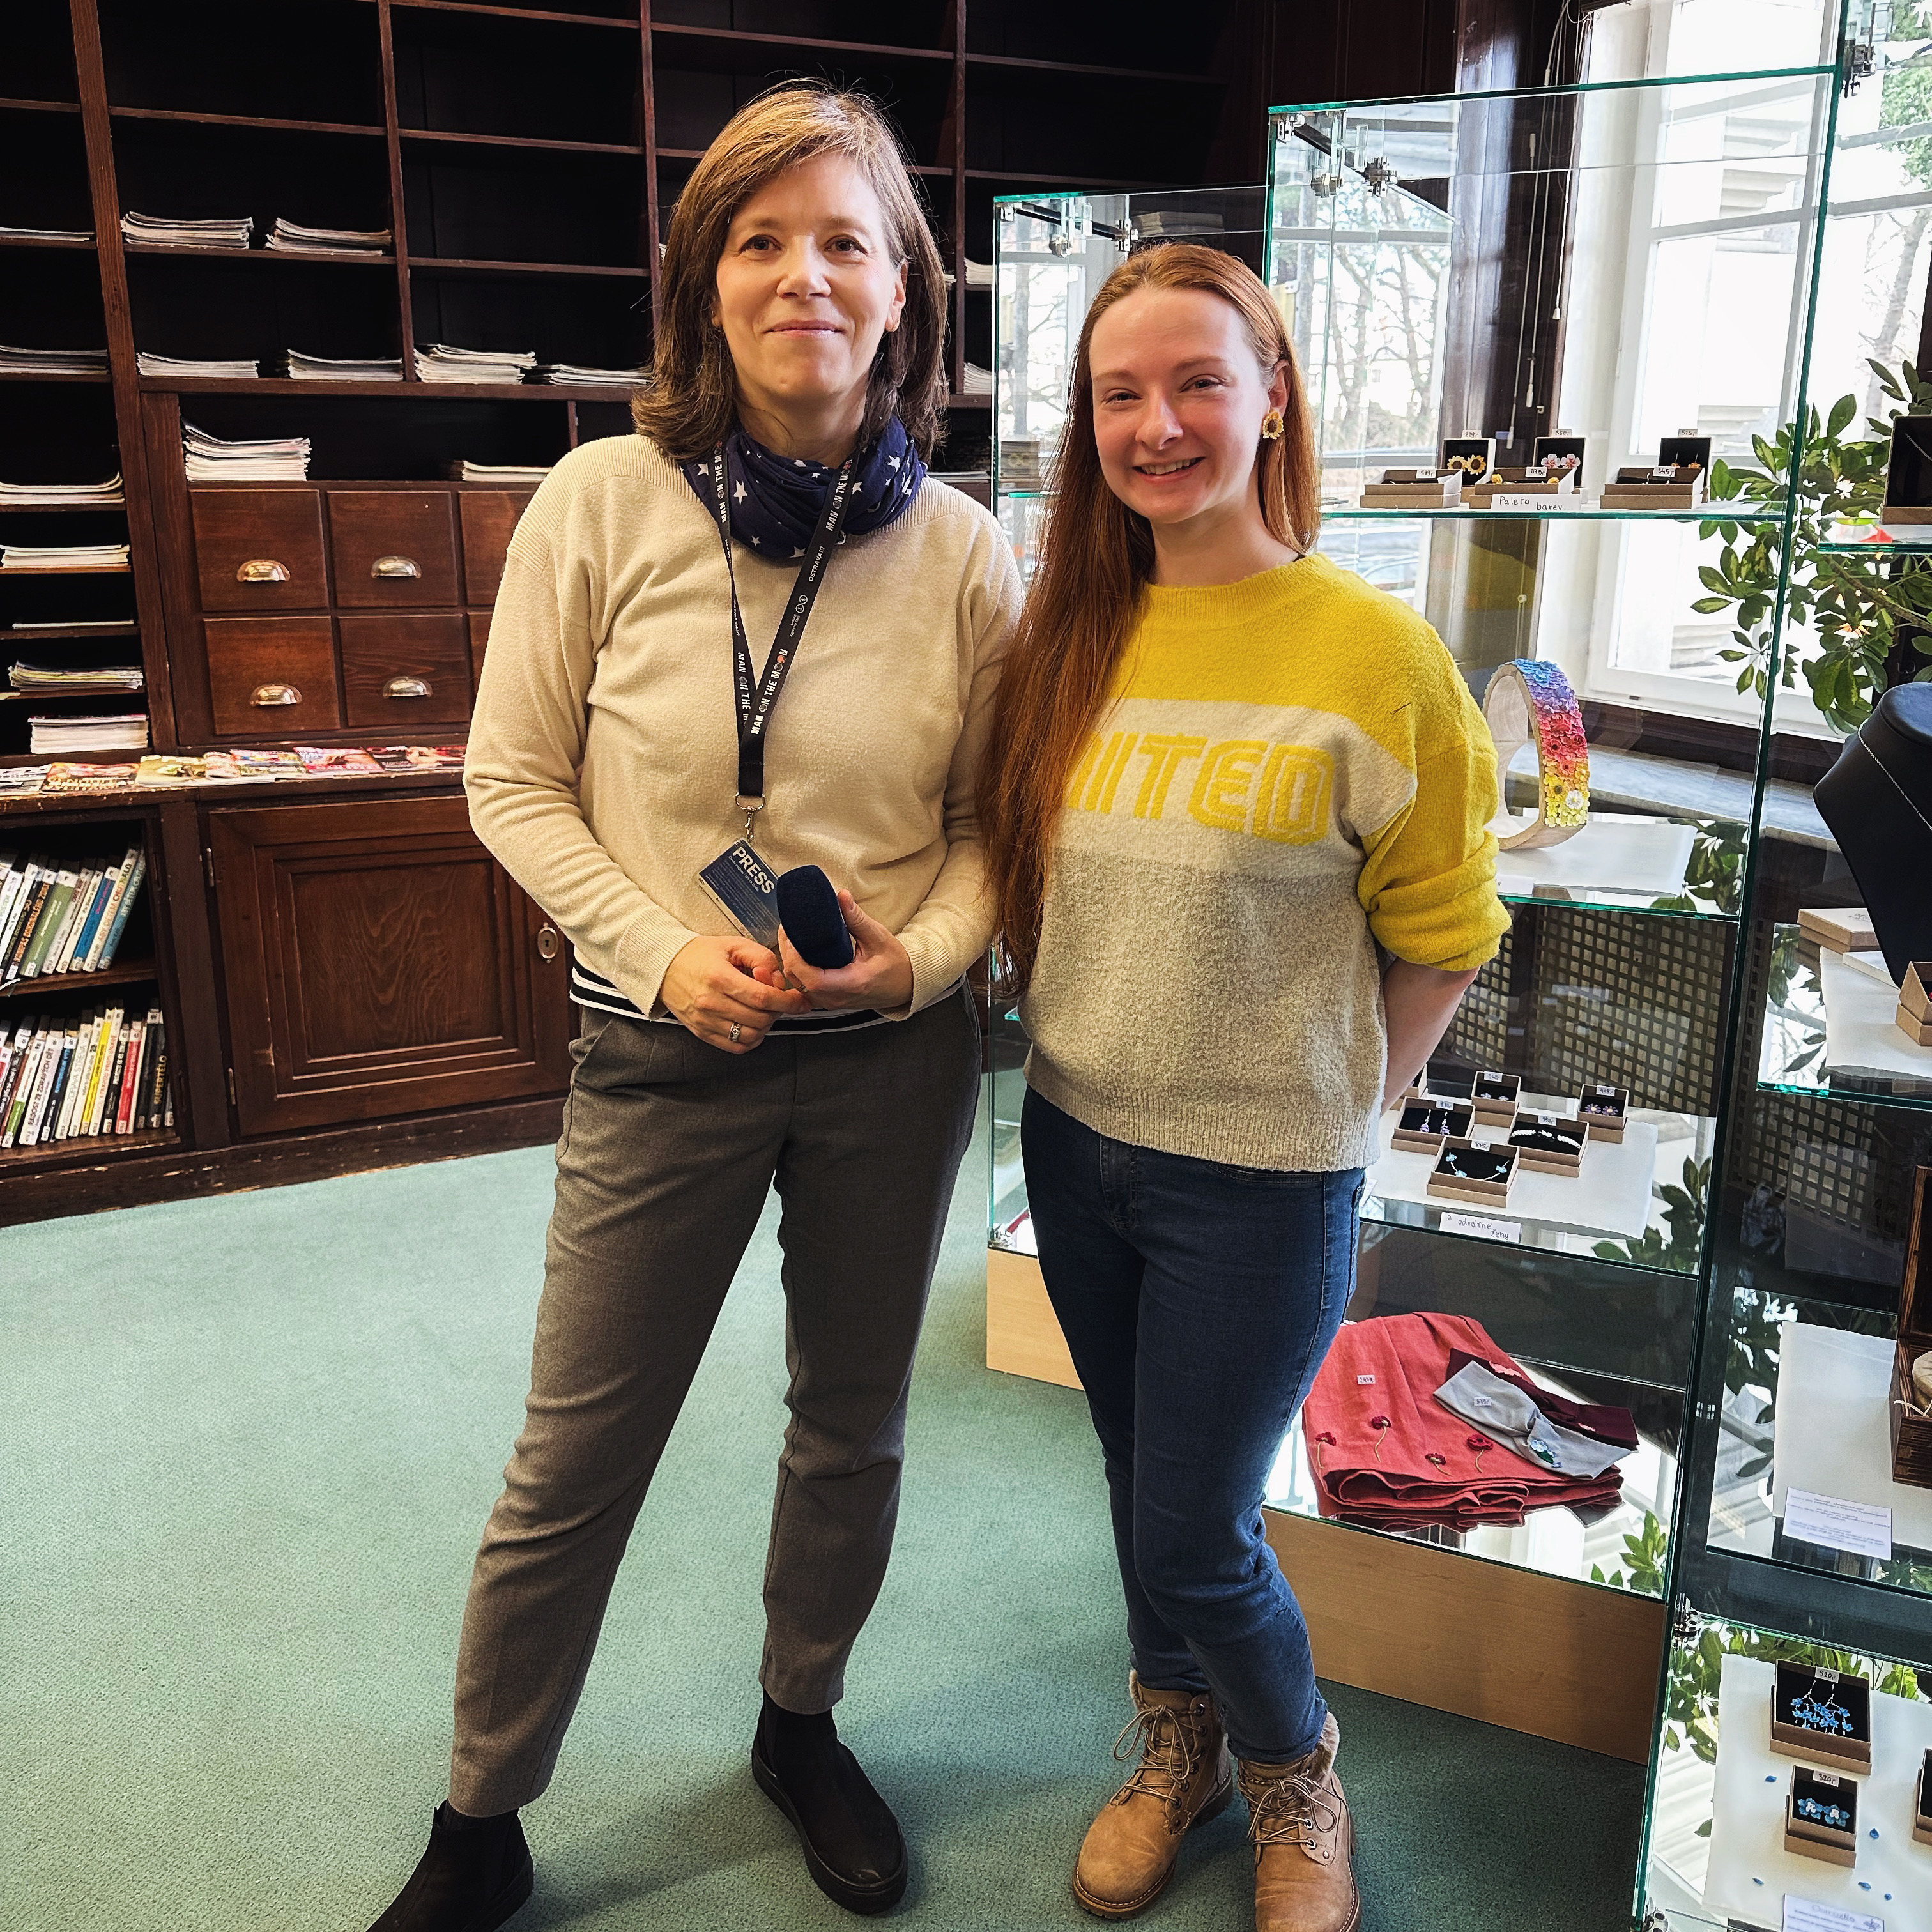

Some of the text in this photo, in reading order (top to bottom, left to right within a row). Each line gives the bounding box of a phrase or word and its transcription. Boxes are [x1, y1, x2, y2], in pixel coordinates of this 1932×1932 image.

[825, 510, 839, 531] MAN
[836, 480, 848, 494] THE
[1499, 496, 1530, 505] Paleta
[808, 546, 825, 582] OSTRAVA!!!
[737, 652, 746, 673] MAN
[741, 693, 751, 710] THE
[751, 648, 788, 735] MAN ON THE MOON
[732, 847, 775, 894] PRESS
